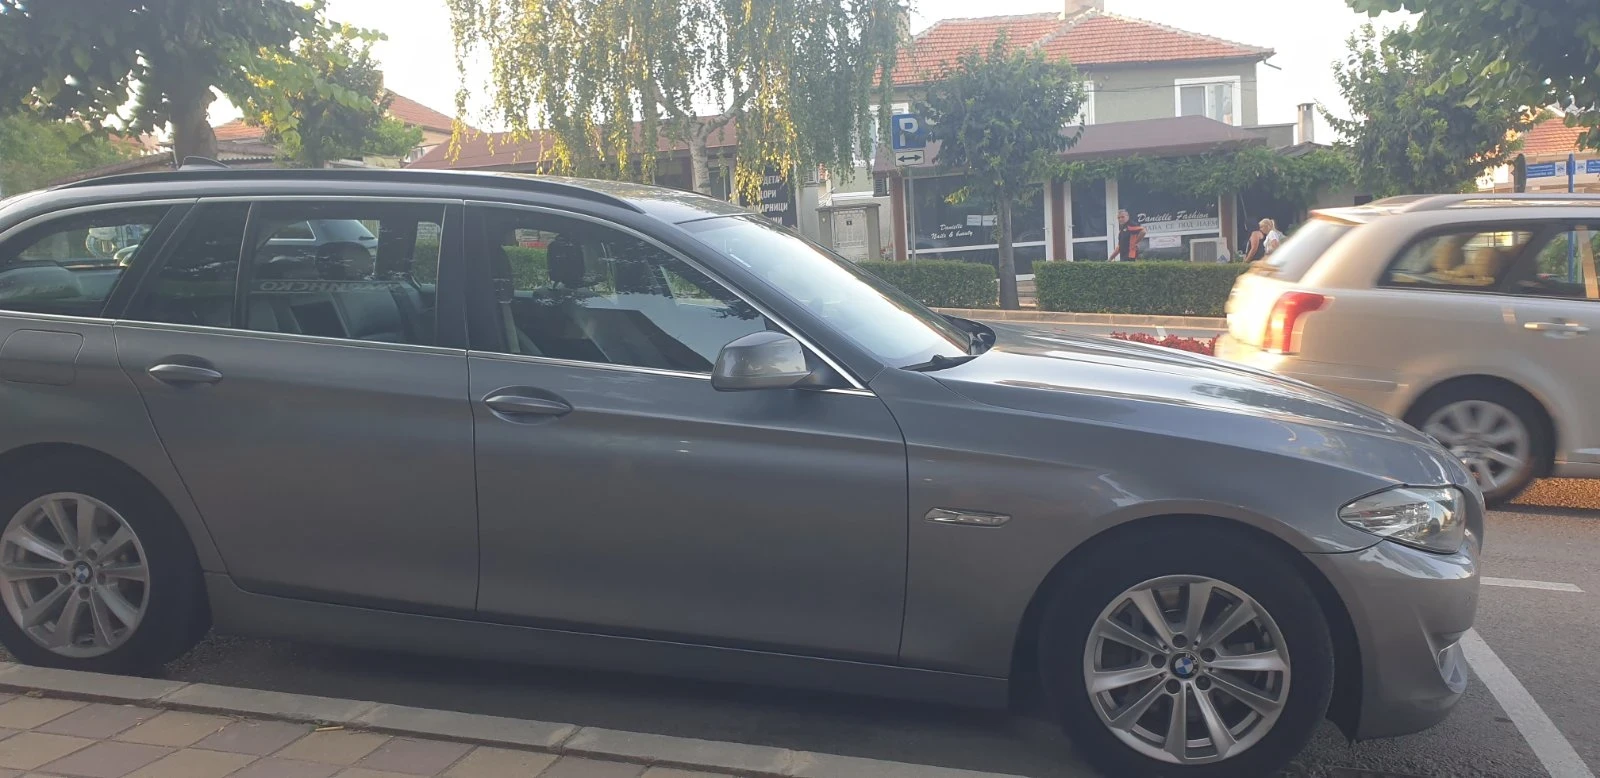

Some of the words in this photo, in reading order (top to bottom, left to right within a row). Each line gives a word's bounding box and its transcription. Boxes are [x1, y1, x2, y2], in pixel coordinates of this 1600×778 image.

[899, 117, 919, 147] P
[1137, 213, 1173, 223] Danielle
[1175, 210, 1209, 221] Fashion
